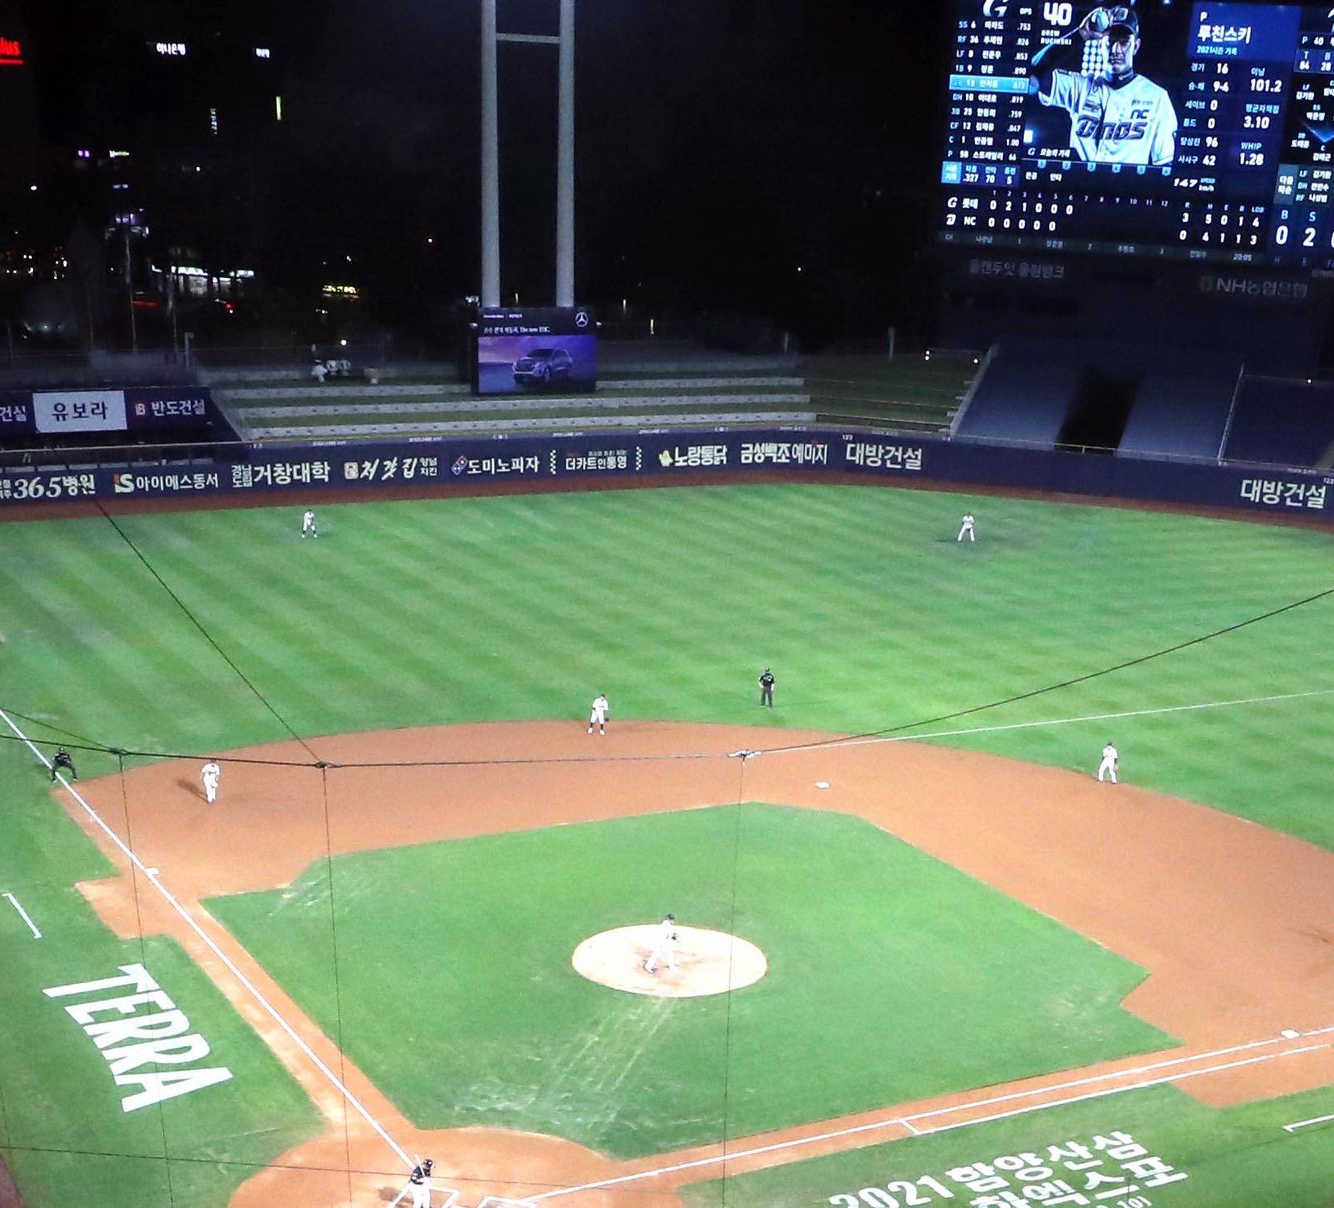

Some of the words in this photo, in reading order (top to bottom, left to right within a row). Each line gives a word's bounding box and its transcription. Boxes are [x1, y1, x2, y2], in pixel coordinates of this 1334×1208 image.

[1043, 2, 1072, 26] 40
[1200, 12, 1208, 22] P
[1197, 25, 1252, 44] 루친스키
[1217, 63, 1229, 75] 16
[1213, 81, 1229, 93] 9-6
[1250, 79, 1282, 93] 101.2
[1210, 99, 1217, 111] 0
[1208, 118, 1215, 129] 0
[1243, 116, 1270, 129] 3.10
[1205, 136, 1218, 148] 96
[1241, 142, 1262, 150] WHIP
[1202, 155, 1216, 166] 42
[1239, 152, 1264, 166] 1.28
[1174, 178, 1198, 188] 147
[990, 200, 997, 210] 0
[1006, 201, 1012, 211] 2
[1035, 203, 1042, 213] 0
[1051, 204, 1058, 214] 0
[1066, 204, 1073, 215] 0
[1182, 213, 1189, 223] 3
[1220, 215, 1228, 225] 0
[1252, 217, 1260, 228] 4
[1281, 210, 1288, 220] B
[1309, 212, 1316, 222] S
[963, 216, 976, 225] NC
[988, 217, 995, 227] 0
[1003, 218, 1010, 228] 0
[1018, 219, 1025, 229] 0
[1033, 220, 1040, 230] 0
[1250, 235, 1257, 245] 3
[1275, 225, 1288, 245] 0
[1302, 227, 1316, 247] 2
[51, 401, 109, 422] 유보라
[151, 399, 206, 417] 반도건설
[674, 445, 727, 467] 노랑통닭
[740, 442, 790, 464] 금성백조
[845, 443, 923, 471] 대방건설
[254, 461, 331, 485] 거창대학
[360, 457, 417, 481] 처갓집
[466, 455, 539, 475] 도미노피자
[12, 474, 96, 498] 365병원
[136, 473, 218, 492] 아이에스동서
[1240, 479, 1327, 510] 대방건설
[43, 963, 233, 1113] TERRA
[945, 1130, 1148, 1193] 함양산삼
